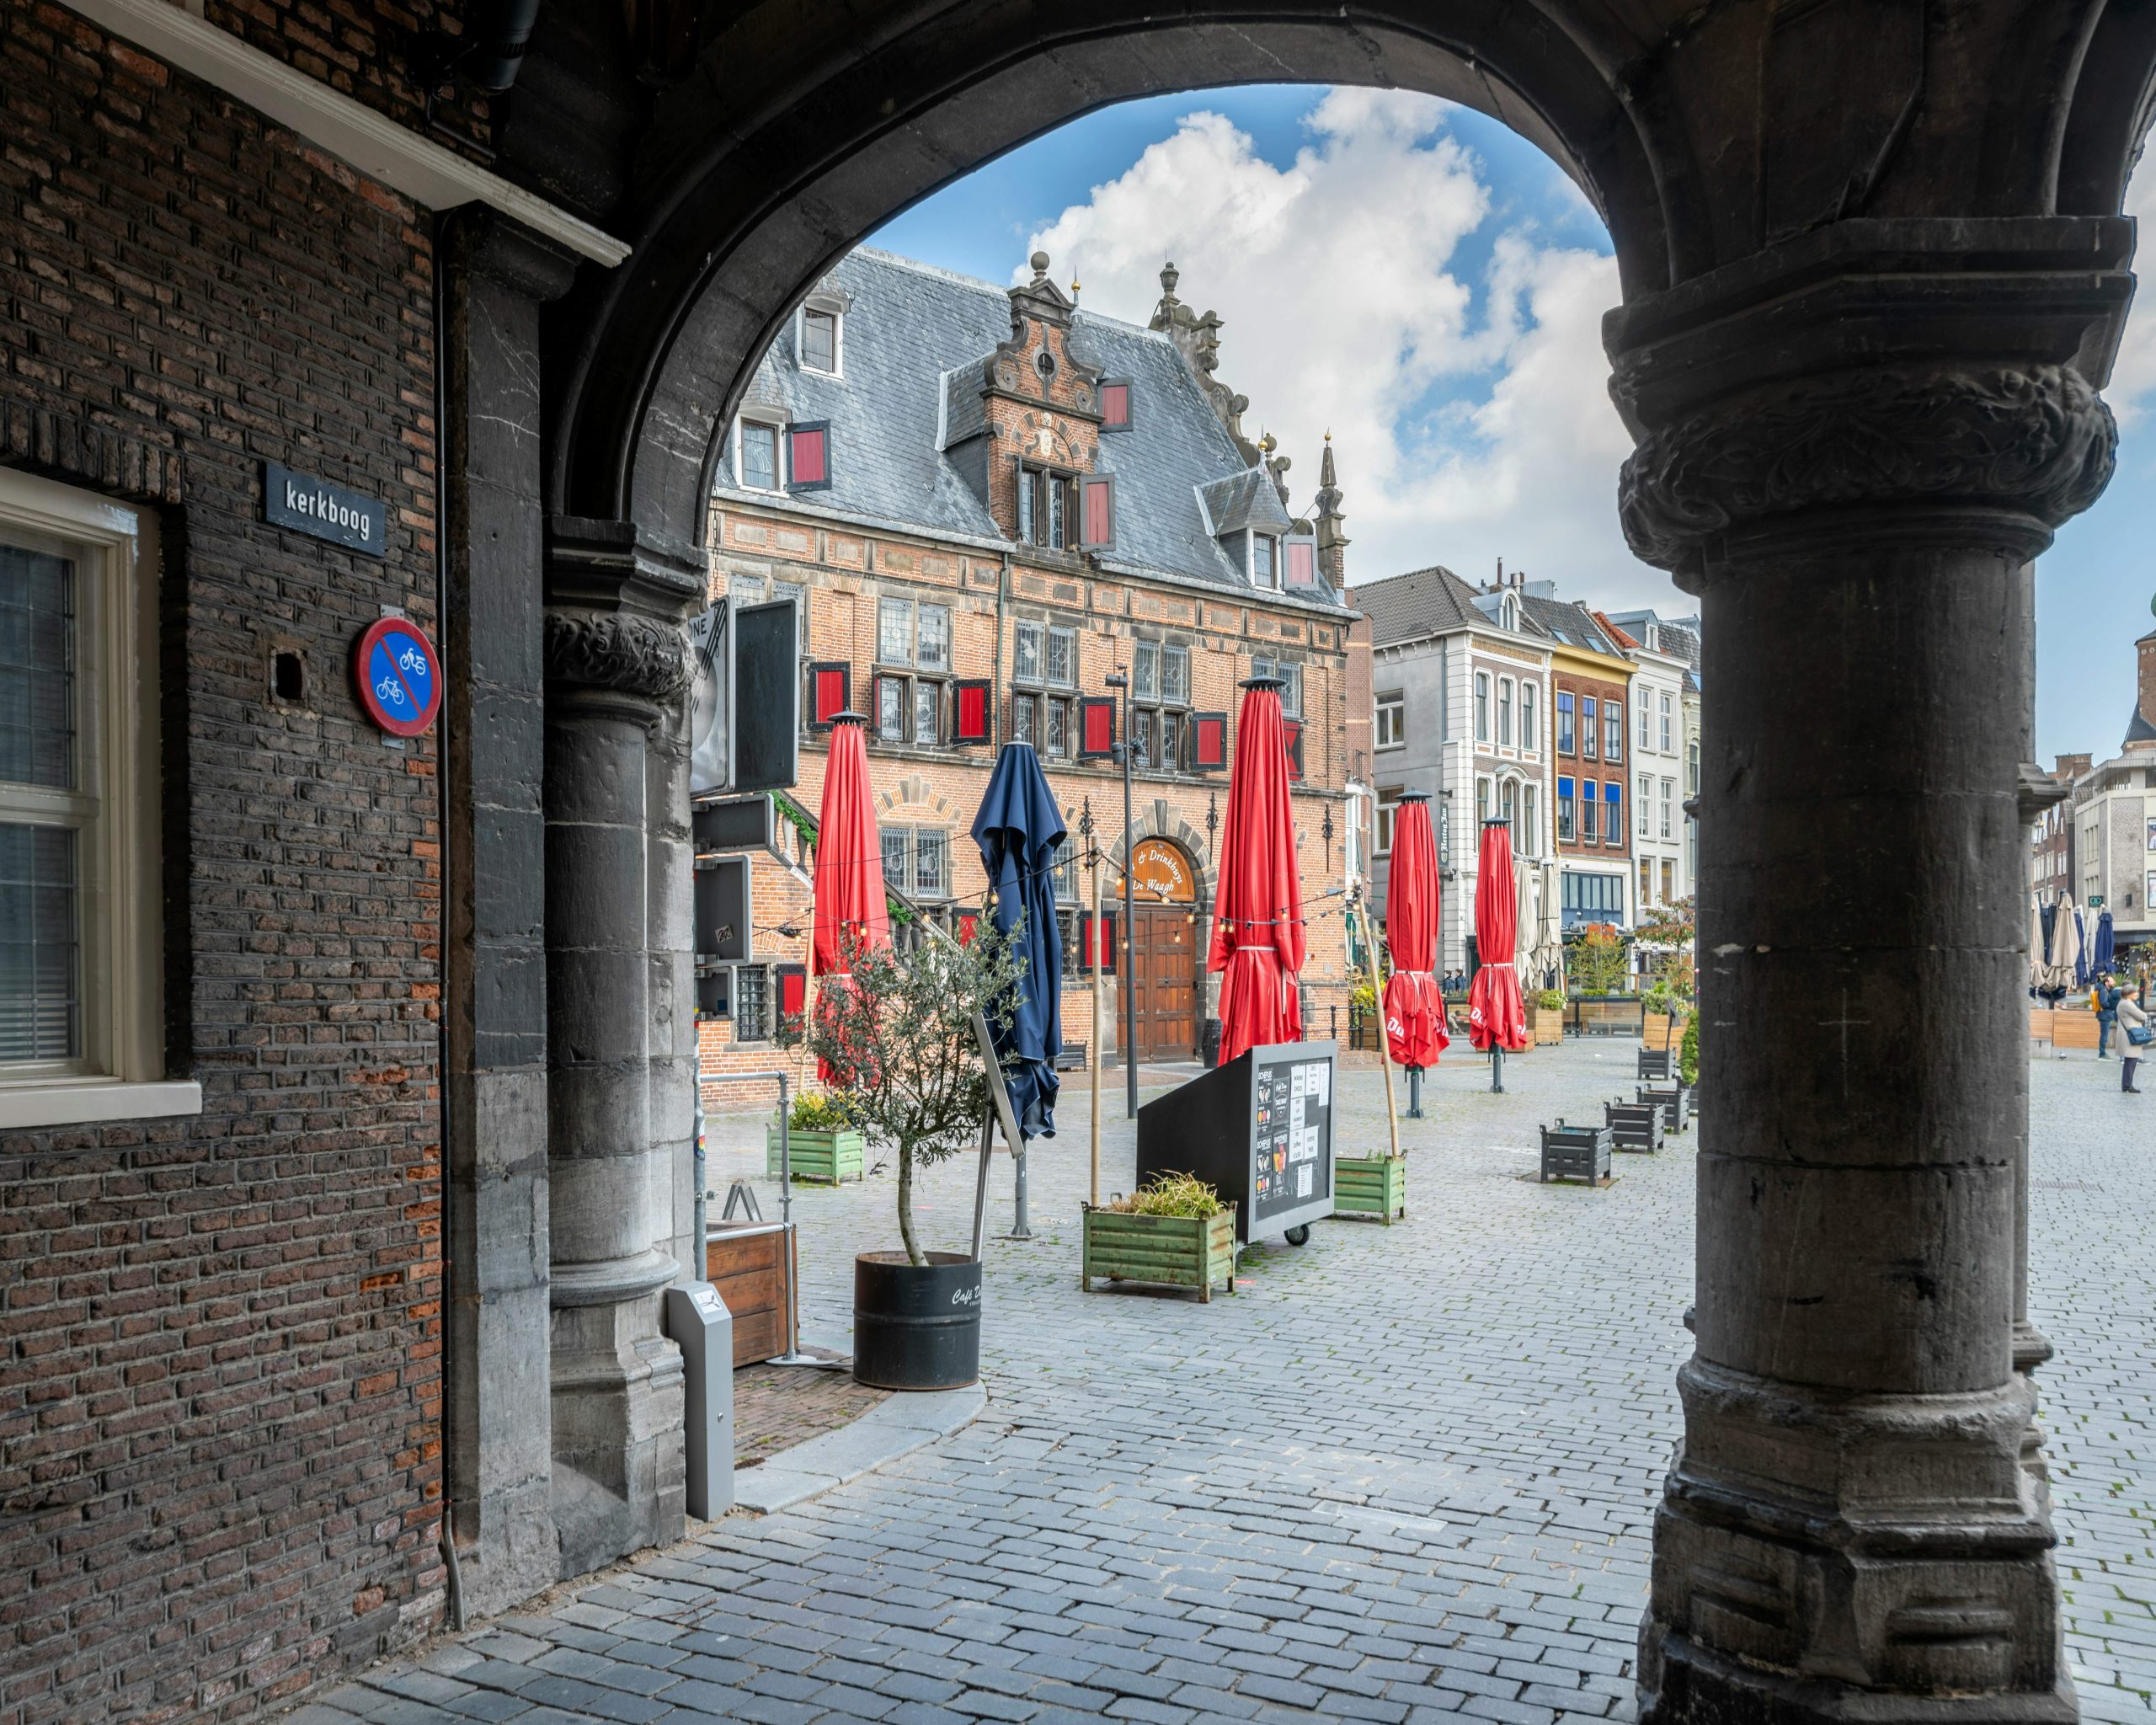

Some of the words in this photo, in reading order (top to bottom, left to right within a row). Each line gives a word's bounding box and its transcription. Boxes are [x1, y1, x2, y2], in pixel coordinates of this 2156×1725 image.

[286, 479, 370, 542] kerkboog
[1146, 879, 1175, 895] Waagh
[952, 1288, 973, 1305] Café
